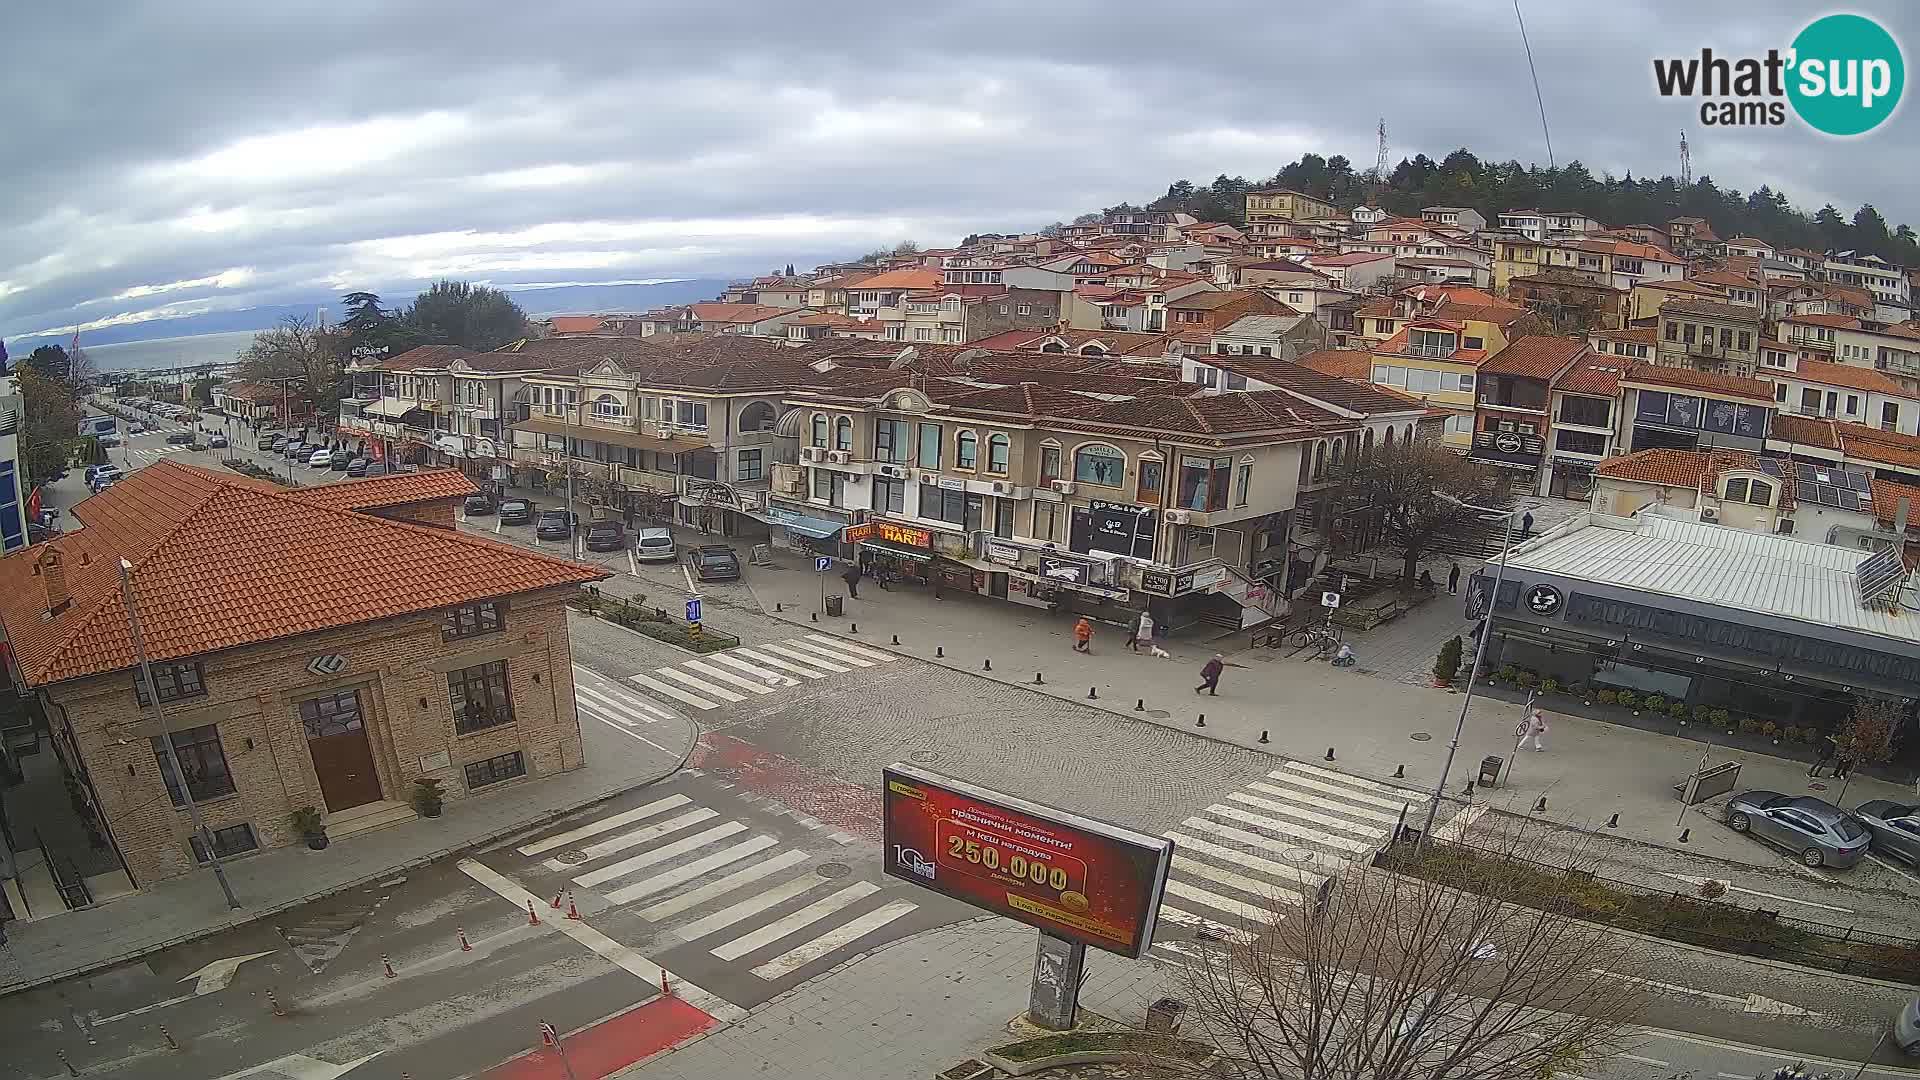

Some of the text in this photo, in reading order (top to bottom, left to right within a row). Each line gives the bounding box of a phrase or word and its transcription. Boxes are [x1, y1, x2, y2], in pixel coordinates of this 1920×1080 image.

[851, 525, 872, 538] HARI
[884, 529, 918, 547] HARI
[819, 558, 828, 570] P
[976, 831, 1000, 845] КЕШ
[1014, 827, 1073, 851] моменти!
[947, 834, 1068, 891] 250.000
